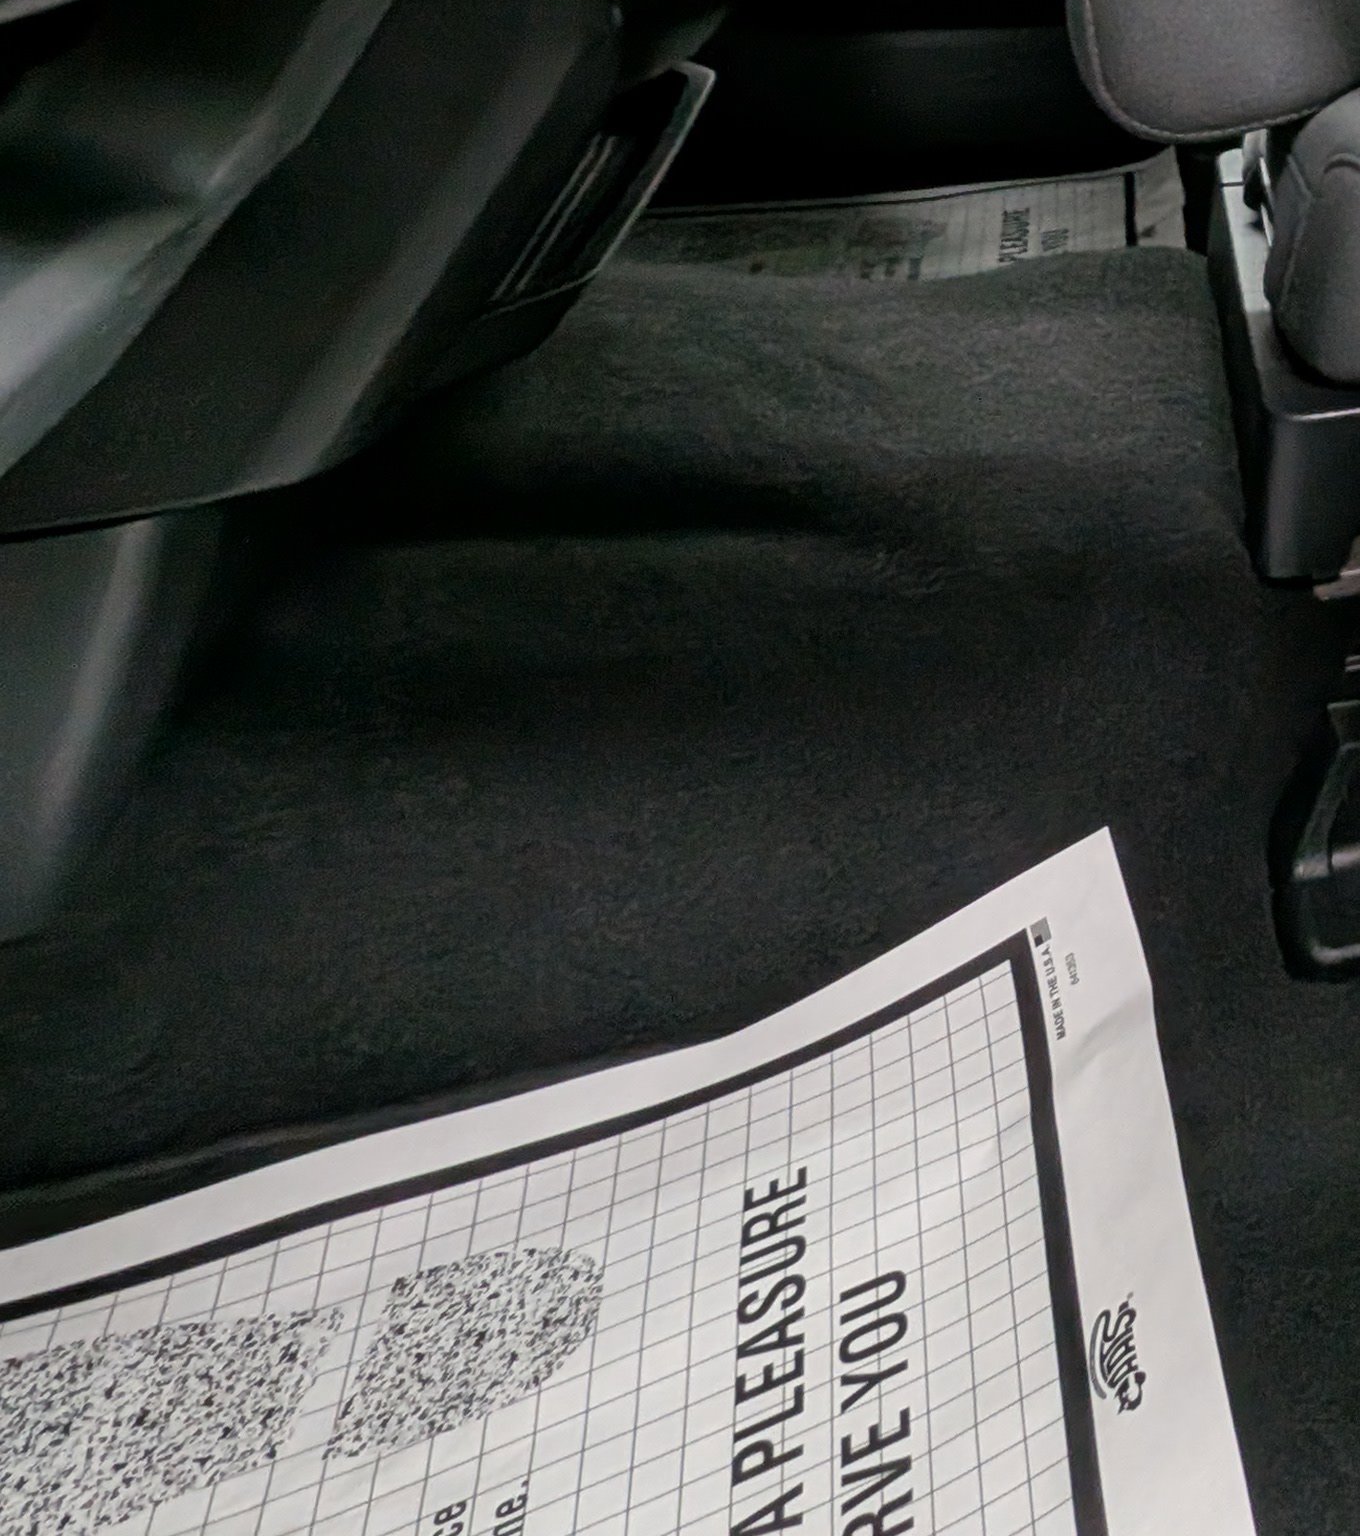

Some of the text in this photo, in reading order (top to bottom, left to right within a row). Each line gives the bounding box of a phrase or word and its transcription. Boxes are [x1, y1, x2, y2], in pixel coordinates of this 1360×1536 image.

[1047, 976, 1059, 998] THE
[1051, 997, 1062, 1010] IN
[1052, 1009, 1066, 1041] MADE
[729, 1165, 808, 1536] A PLEASURE
[839, 1269, 909, 1415] YOU
